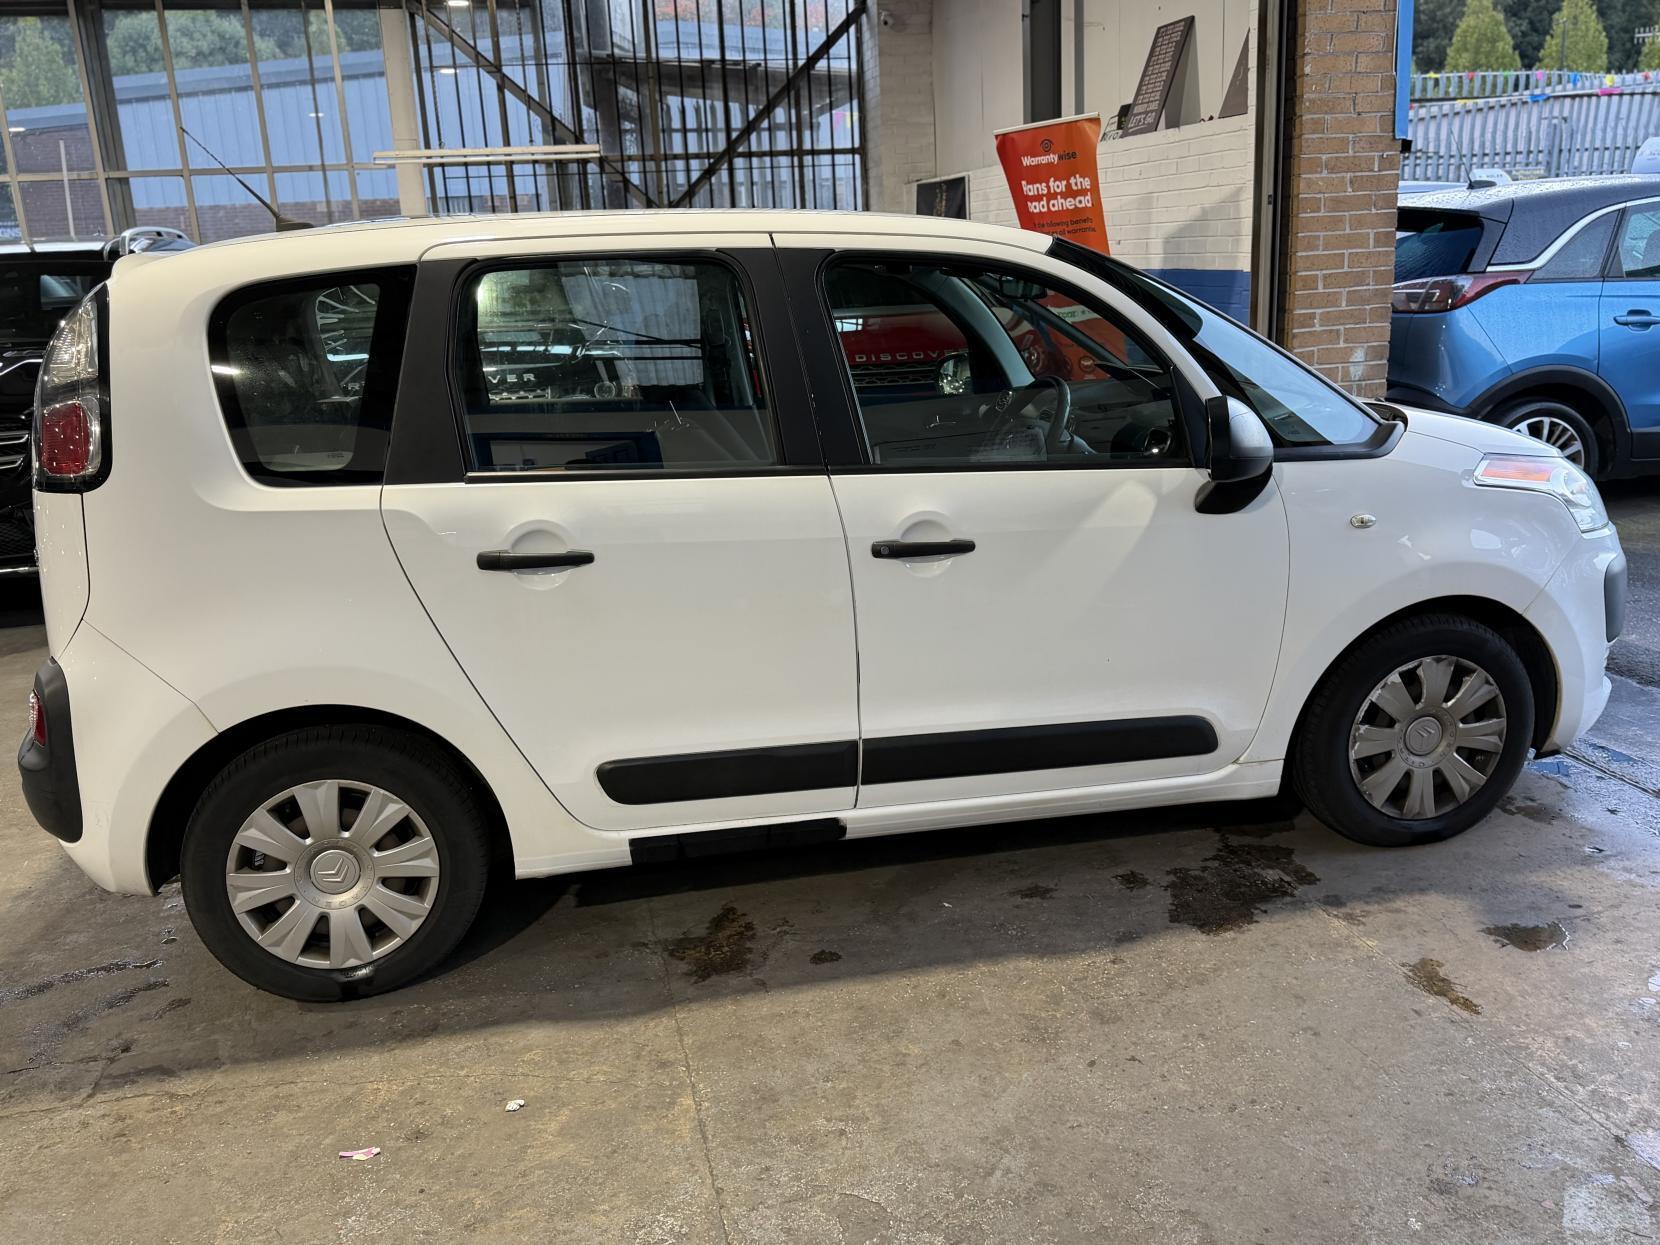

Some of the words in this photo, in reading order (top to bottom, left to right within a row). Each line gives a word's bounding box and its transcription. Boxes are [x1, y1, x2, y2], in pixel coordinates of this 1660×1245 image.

[1021, 150, 1077, 167] Warrantywise
[1049, 177, 1067, 193] for
[1070, 174, 1091, 190] the
[1049, 192, 1092, 211] ahead
[487, 373, 536, 384] VER
